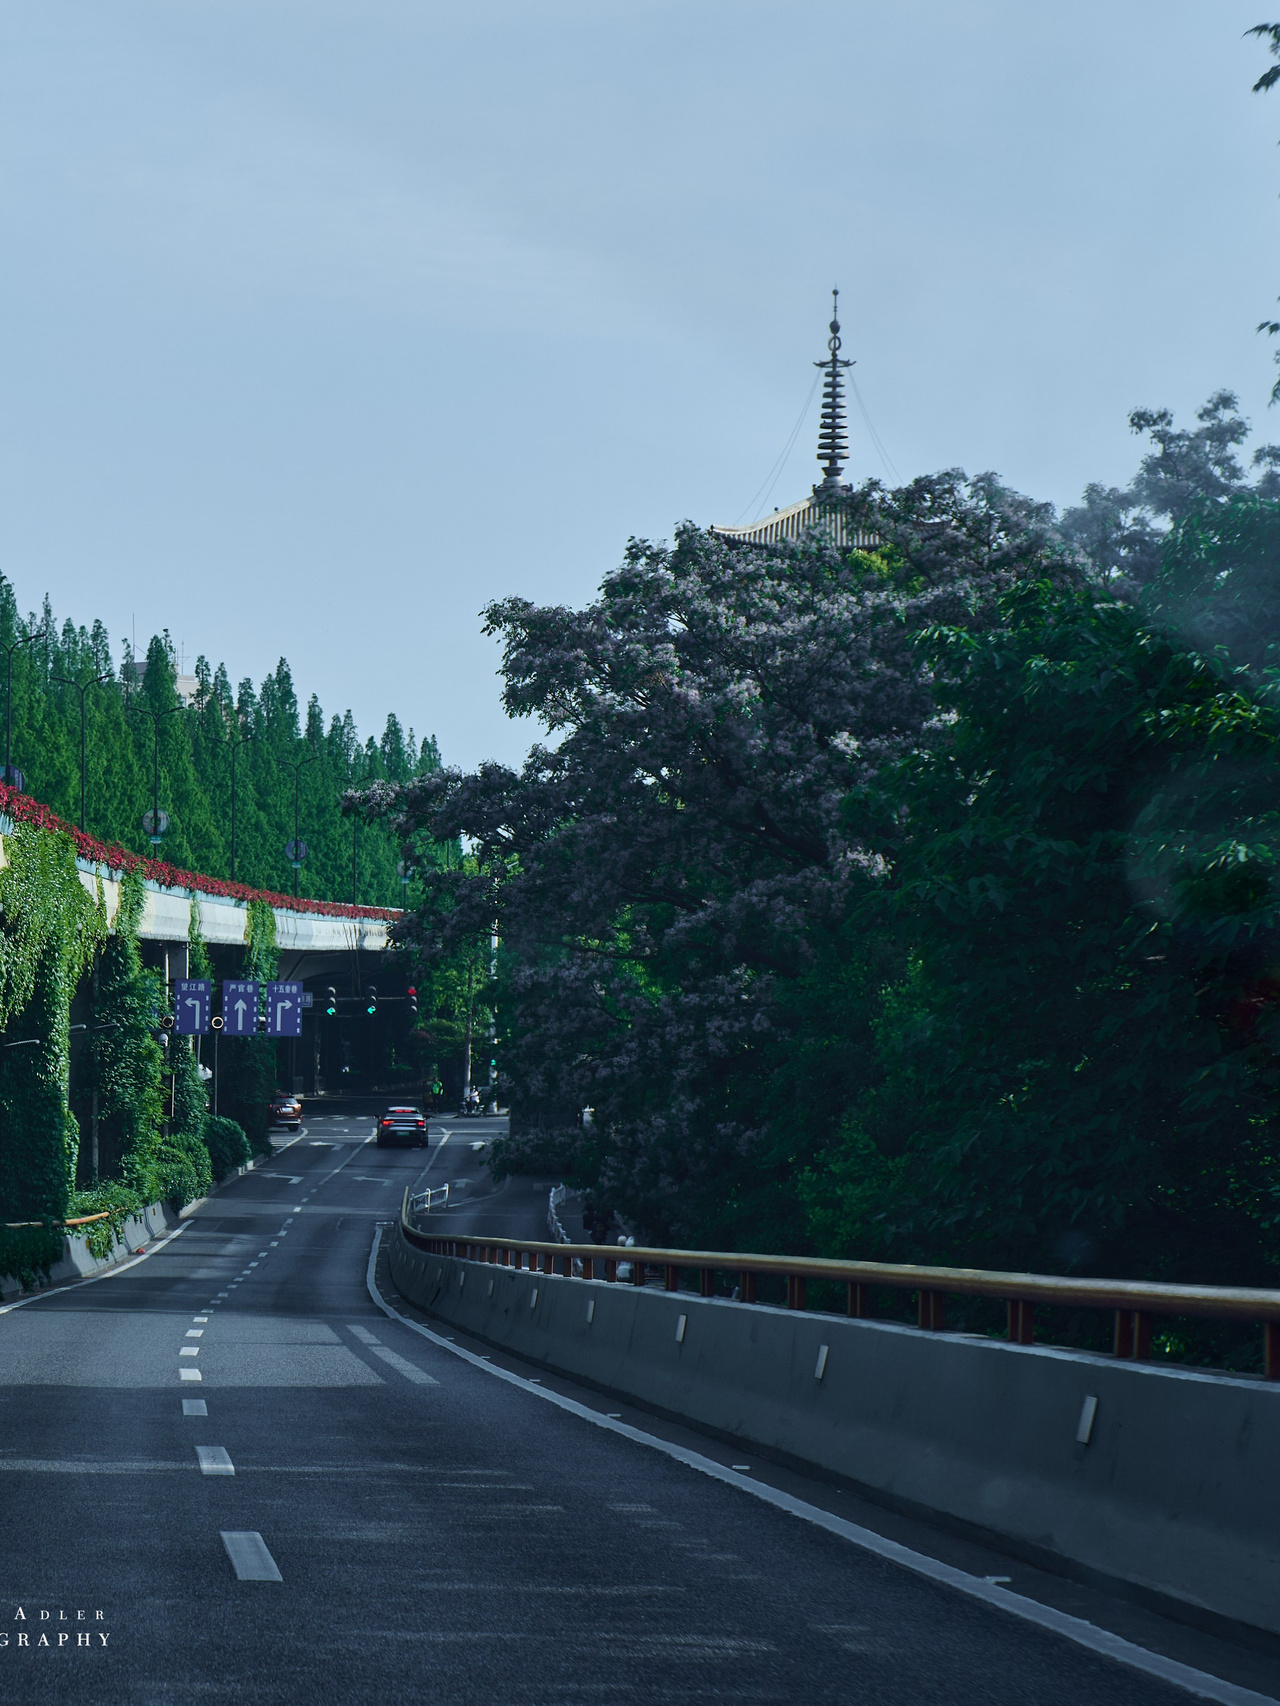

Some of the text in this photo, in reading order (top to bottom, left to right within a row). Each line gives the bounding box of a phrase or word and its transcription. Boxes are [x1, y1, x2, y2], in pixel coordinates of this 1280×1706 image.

[181, 983, 205, 992] 望江路
[229, 984, 254, 993] 严官巷
